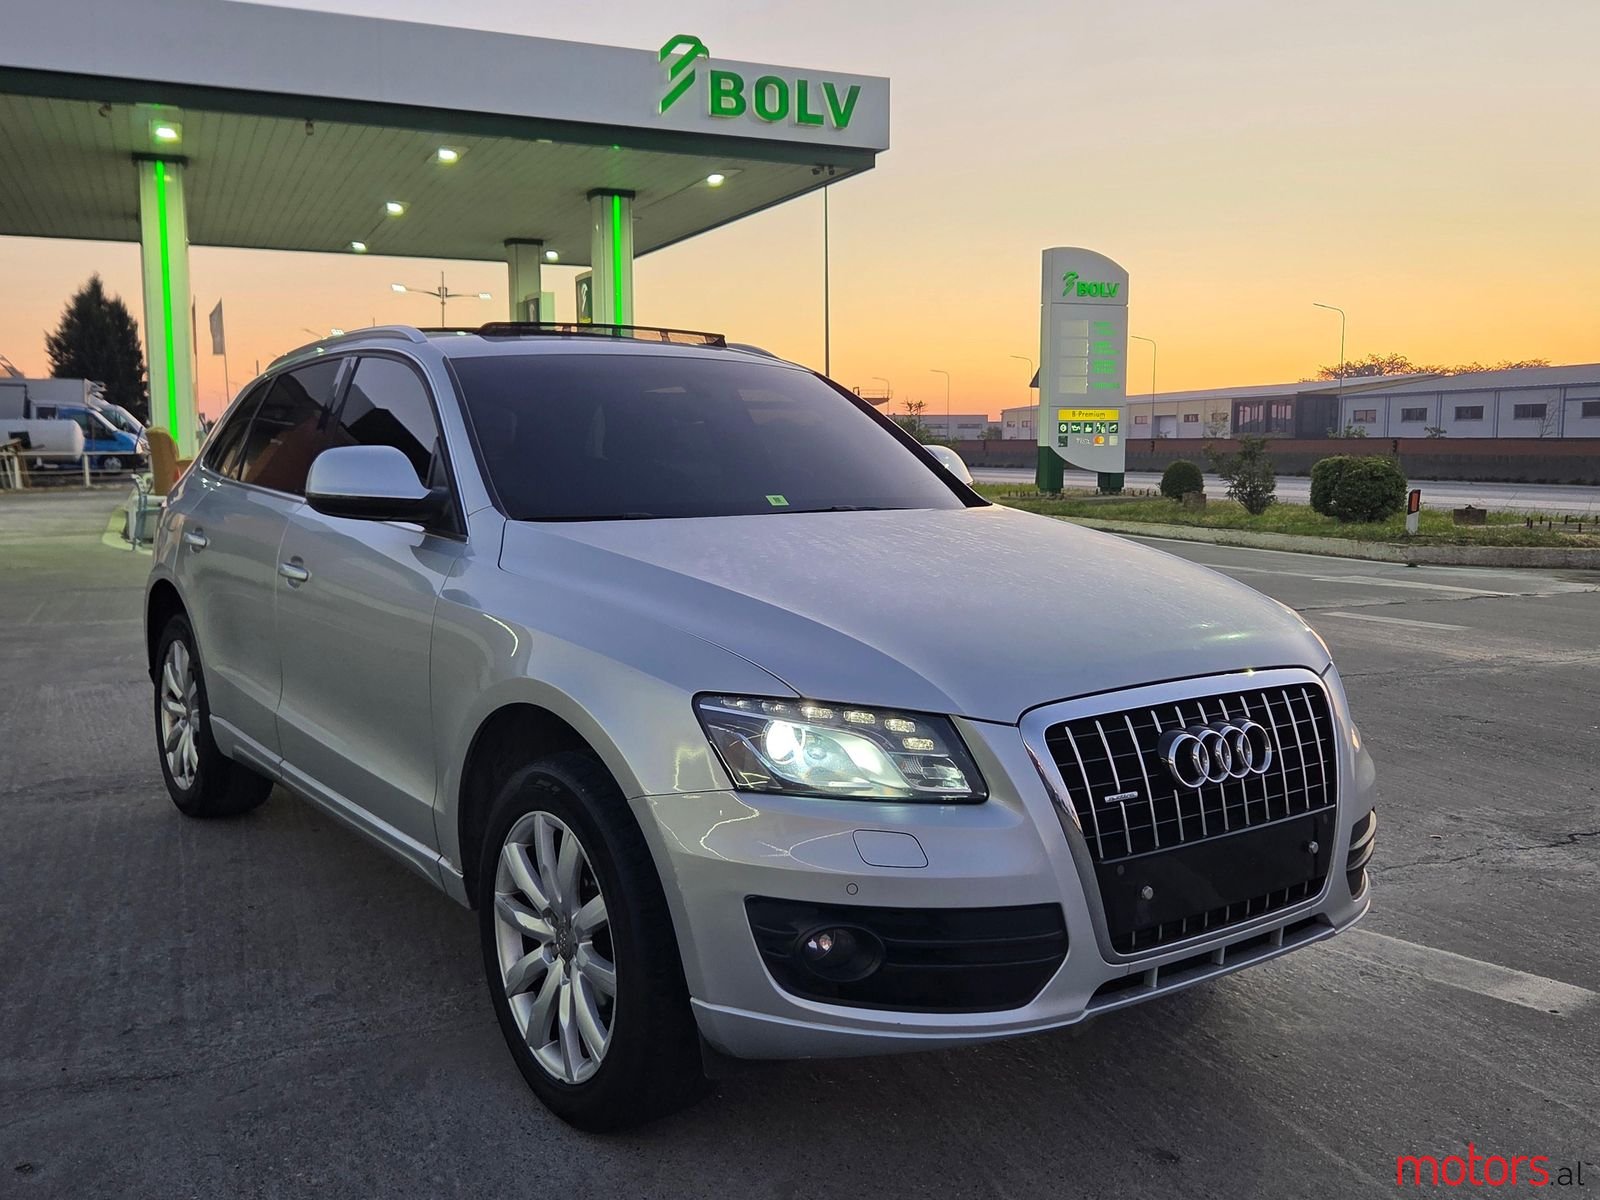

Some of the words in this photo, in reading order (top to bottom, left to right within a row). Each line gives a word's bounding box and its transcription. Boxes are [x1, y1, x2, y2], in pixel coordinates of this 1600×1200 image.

[708, 69, 862, 129] BOLV
[1077, 281, 1120, 298] BOLV
[1078, 410, 1106, 419] Premium
